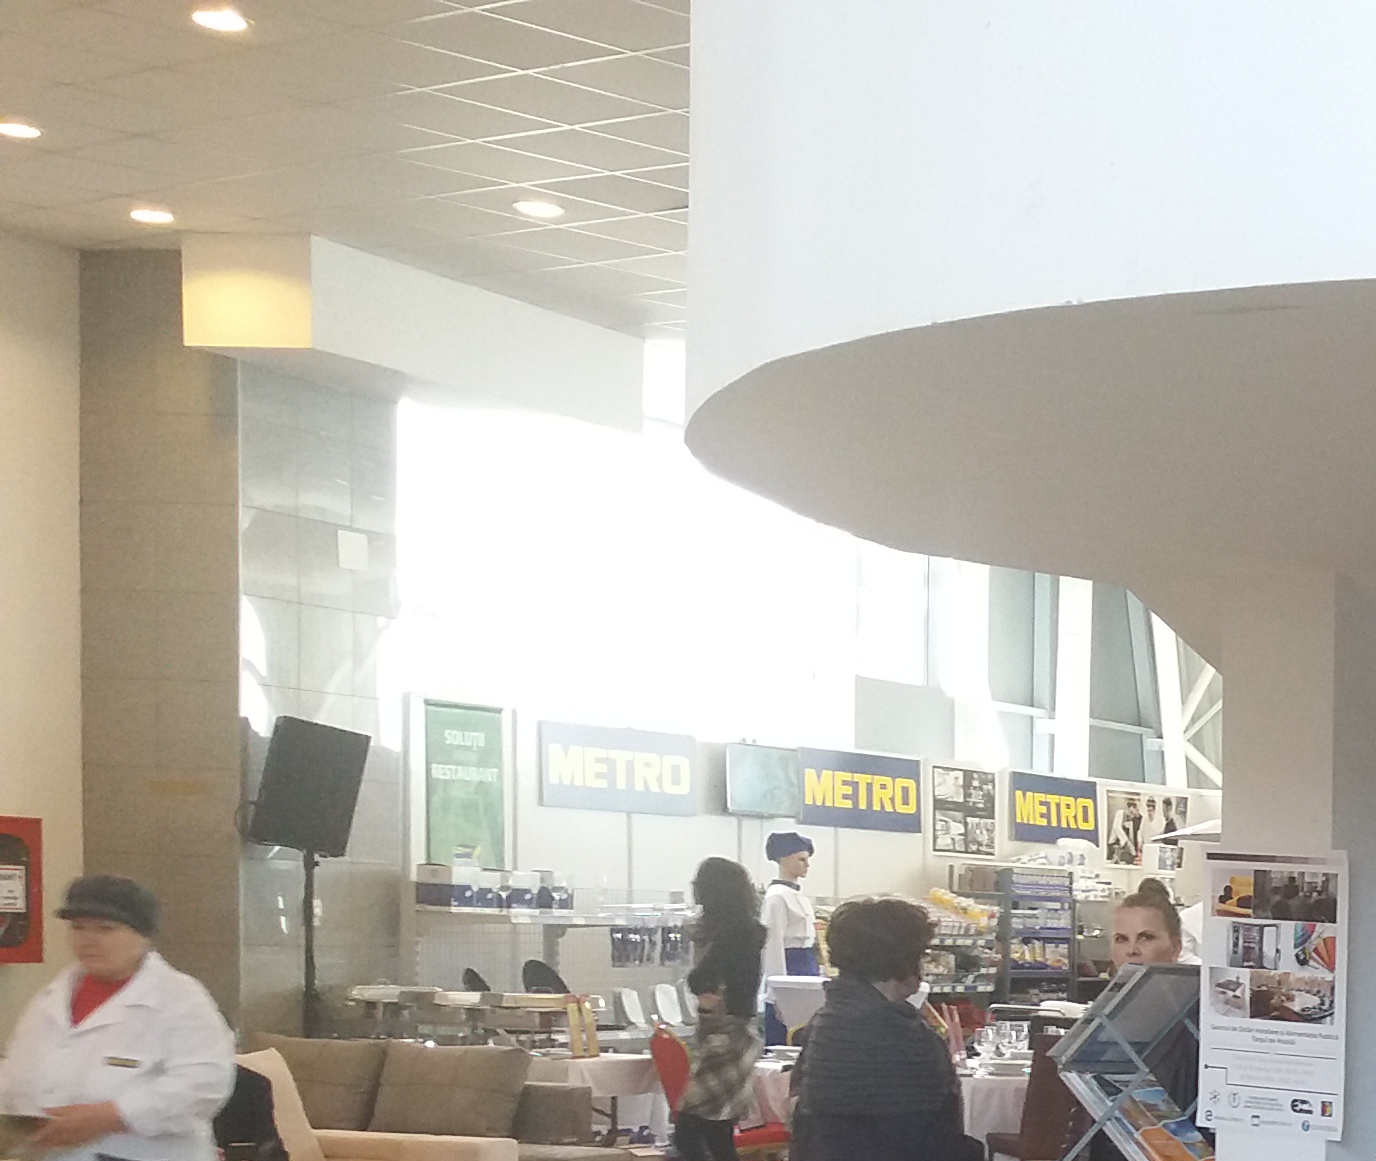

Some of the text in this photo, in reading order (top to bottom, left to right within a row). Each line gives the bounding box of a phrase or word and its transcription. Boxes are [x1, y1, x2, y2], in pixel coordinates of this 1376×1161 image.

[549, 743, 691, 795] METRO
[804, 768, 917, 814] METRO
[1016, 790, 1095, 831] METRO
